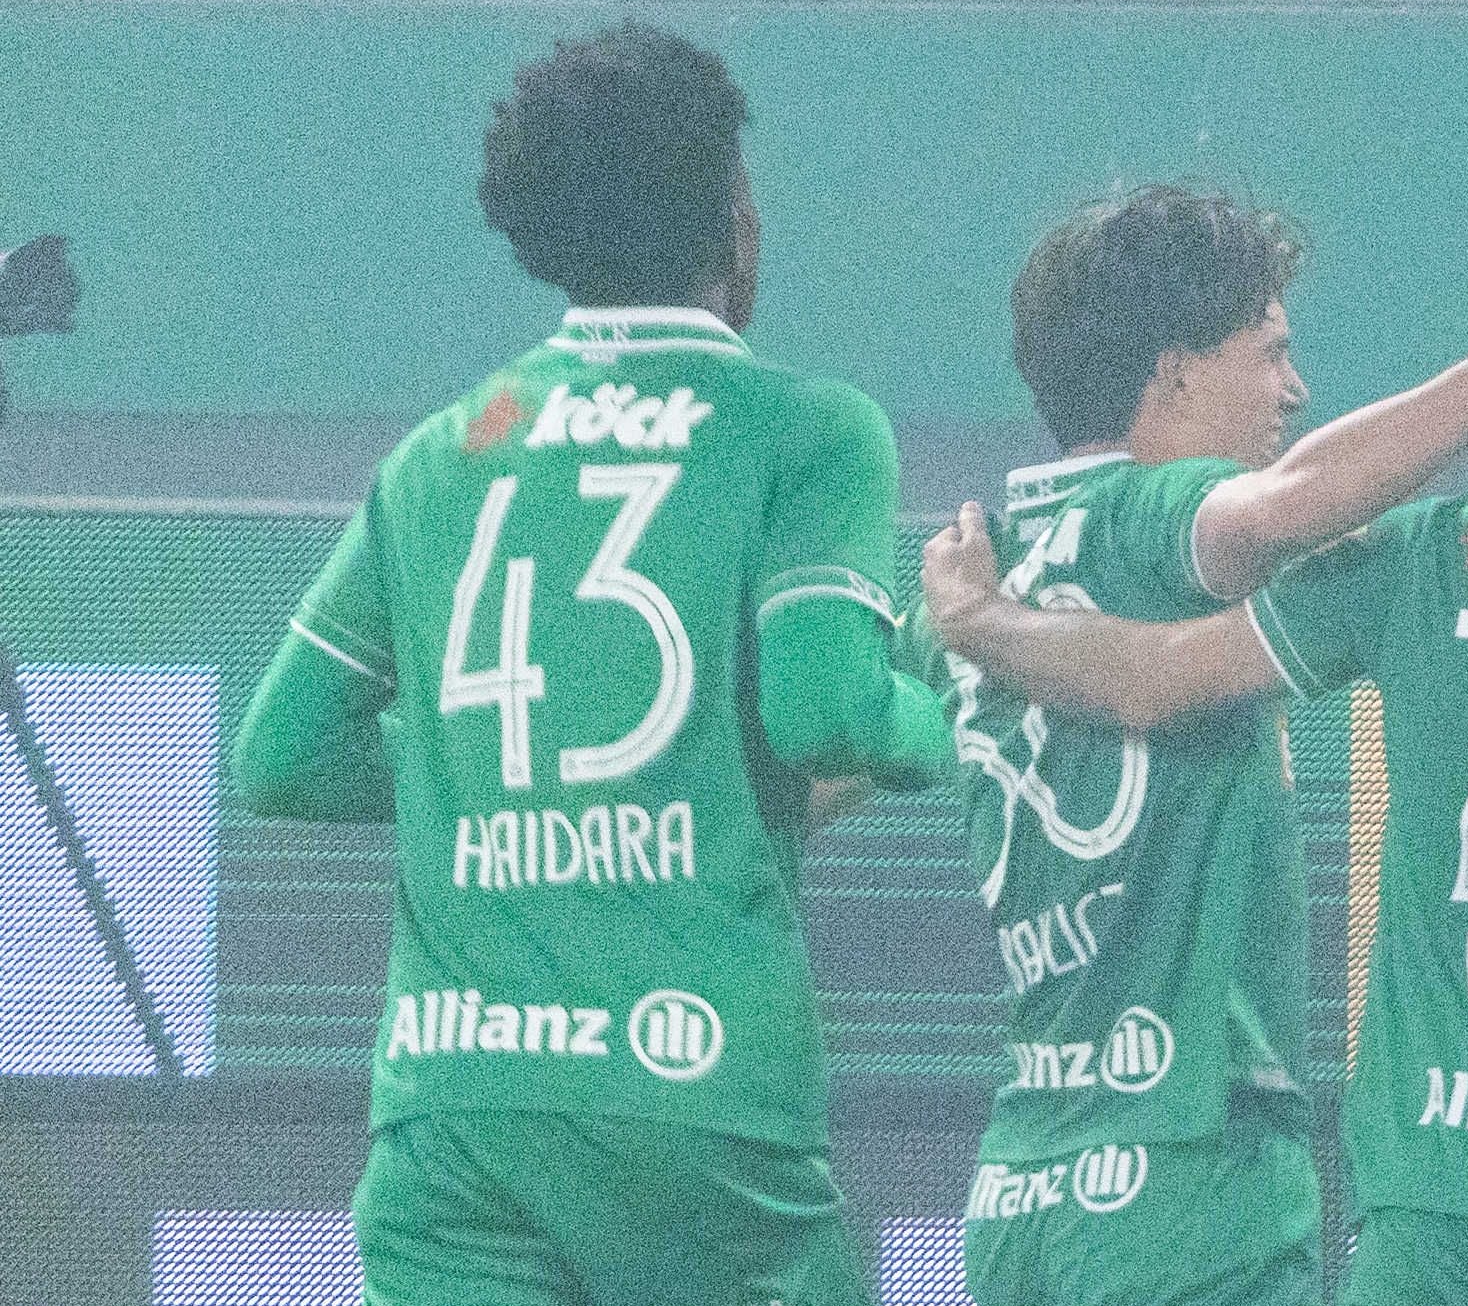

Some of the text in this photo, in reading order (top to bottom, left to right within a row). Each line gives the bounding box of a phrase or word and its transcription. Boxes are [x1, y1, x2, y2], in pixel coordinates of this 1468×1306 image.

[439, 462, 696, 789] 43
[453, 801, 697, 889] HAIDARA
[386, 989, 610, 1061] Allianz
